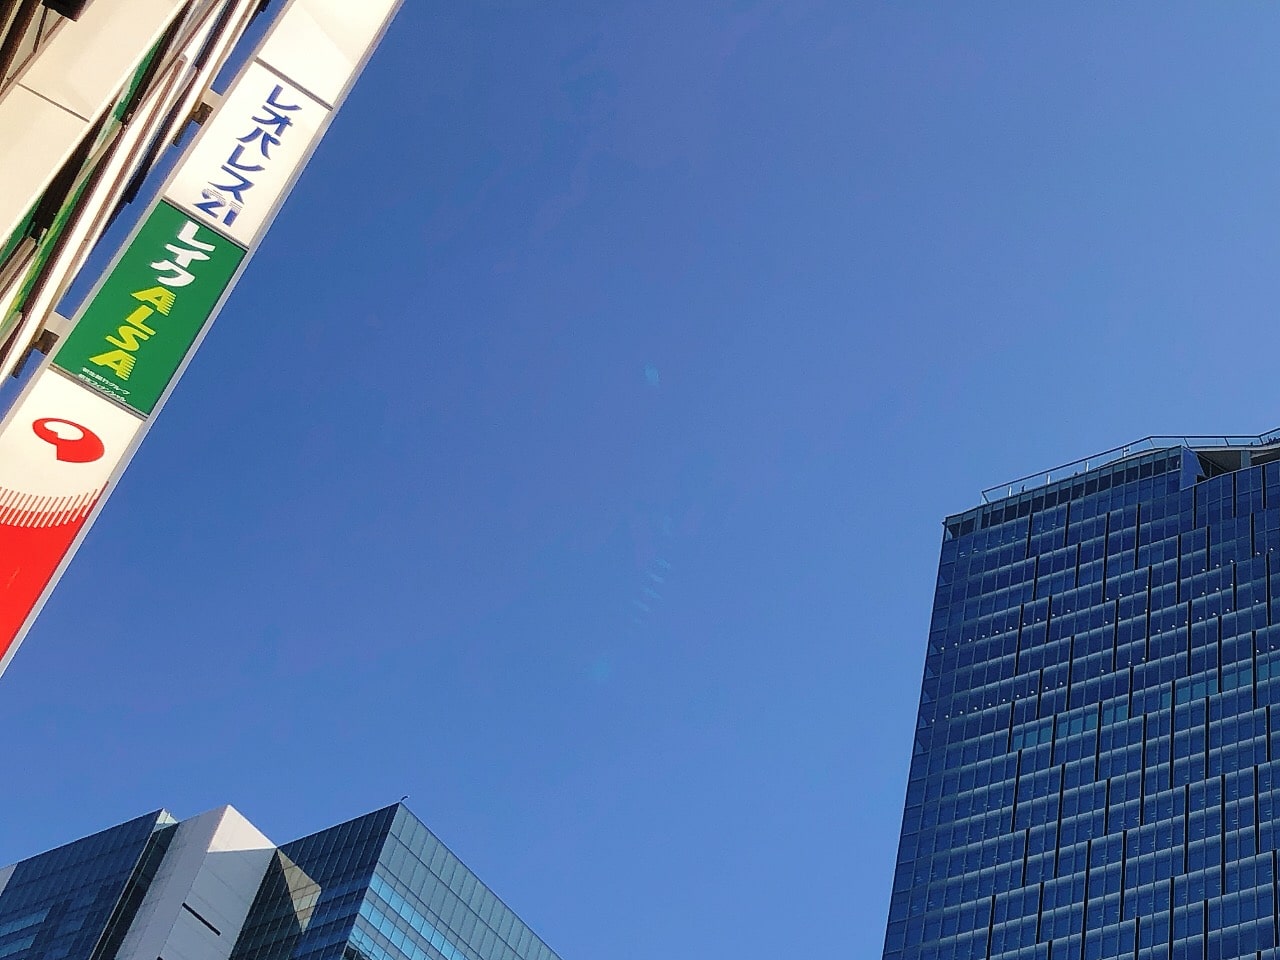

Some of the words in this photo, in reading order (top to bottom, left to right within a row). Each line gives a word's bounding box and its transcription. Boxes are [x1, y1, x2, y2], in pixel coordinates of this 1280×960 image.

[192, 84, 303, 227] レオパレス21
